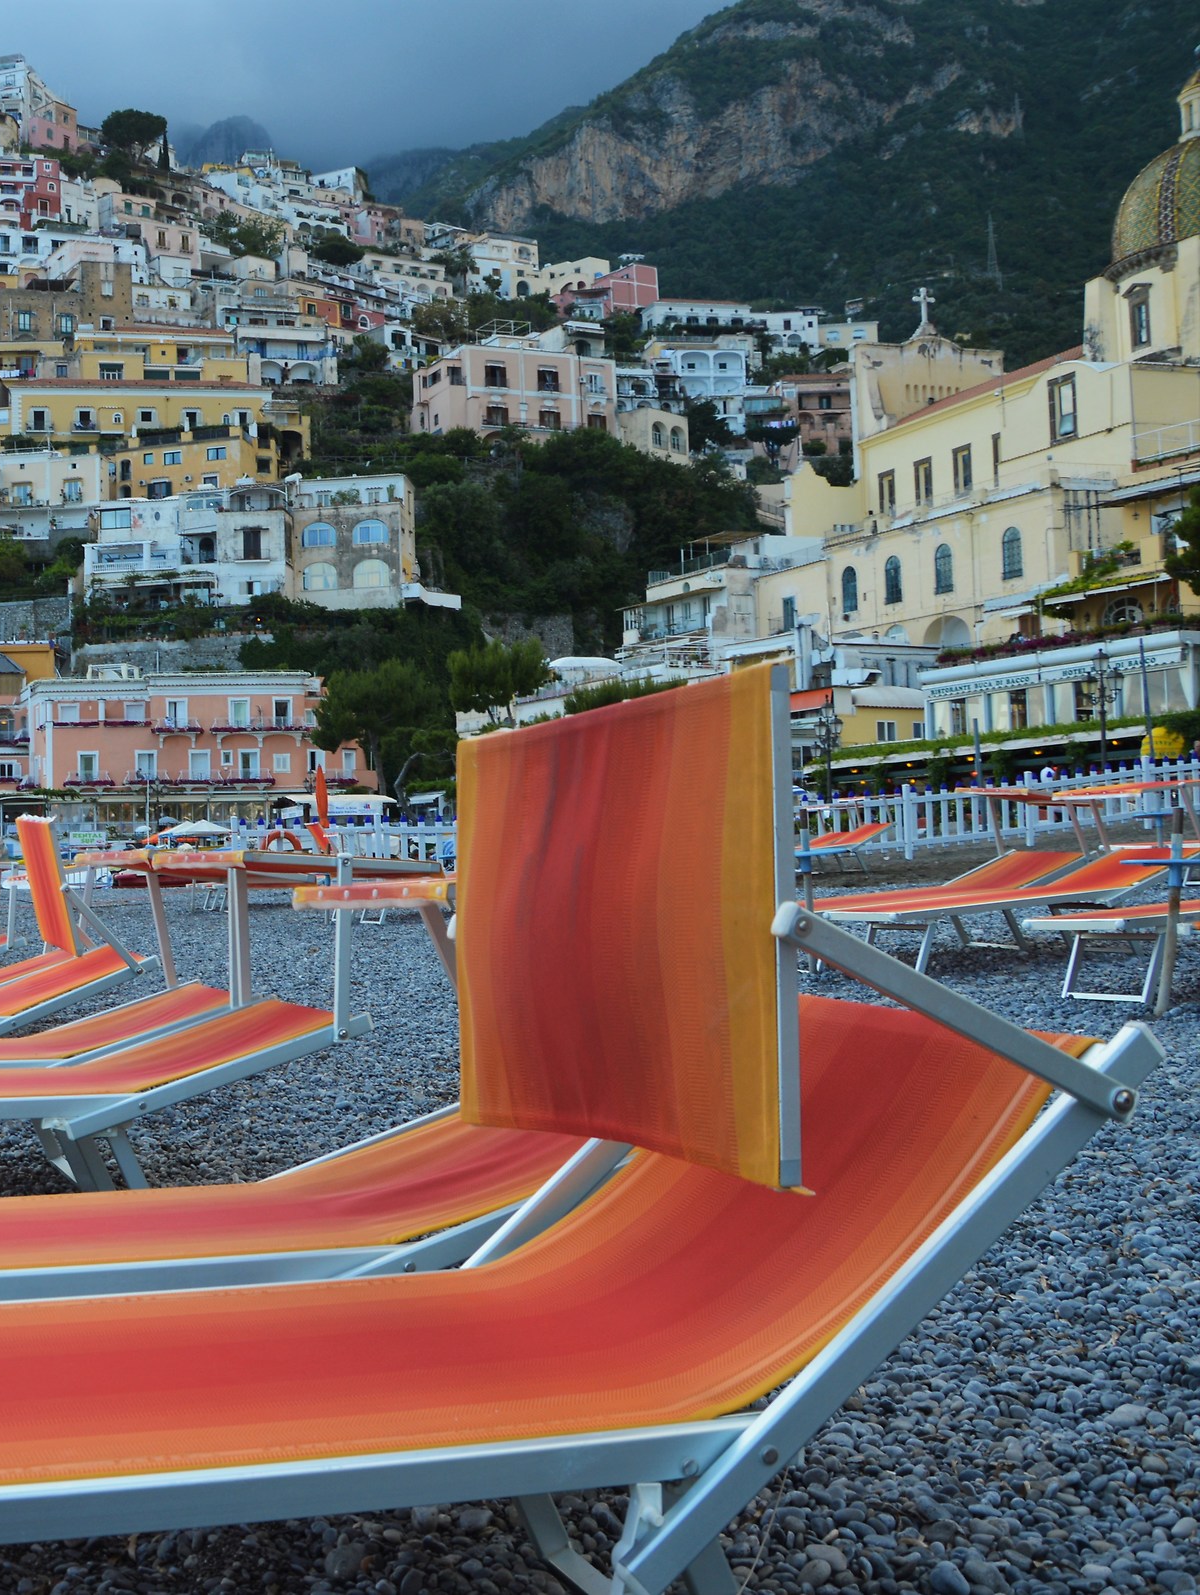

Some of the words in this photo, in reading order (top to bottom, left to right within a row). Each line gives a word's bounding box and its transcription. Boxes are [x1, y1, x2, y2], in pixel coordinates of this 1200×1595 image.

[1062, 668, 1086, 676] HOTEL
[1128, 657, 1156, 666] BACO
[930, 685, 971, 695] RISTORANTE
[974, 681, 992, 689] BUCA
